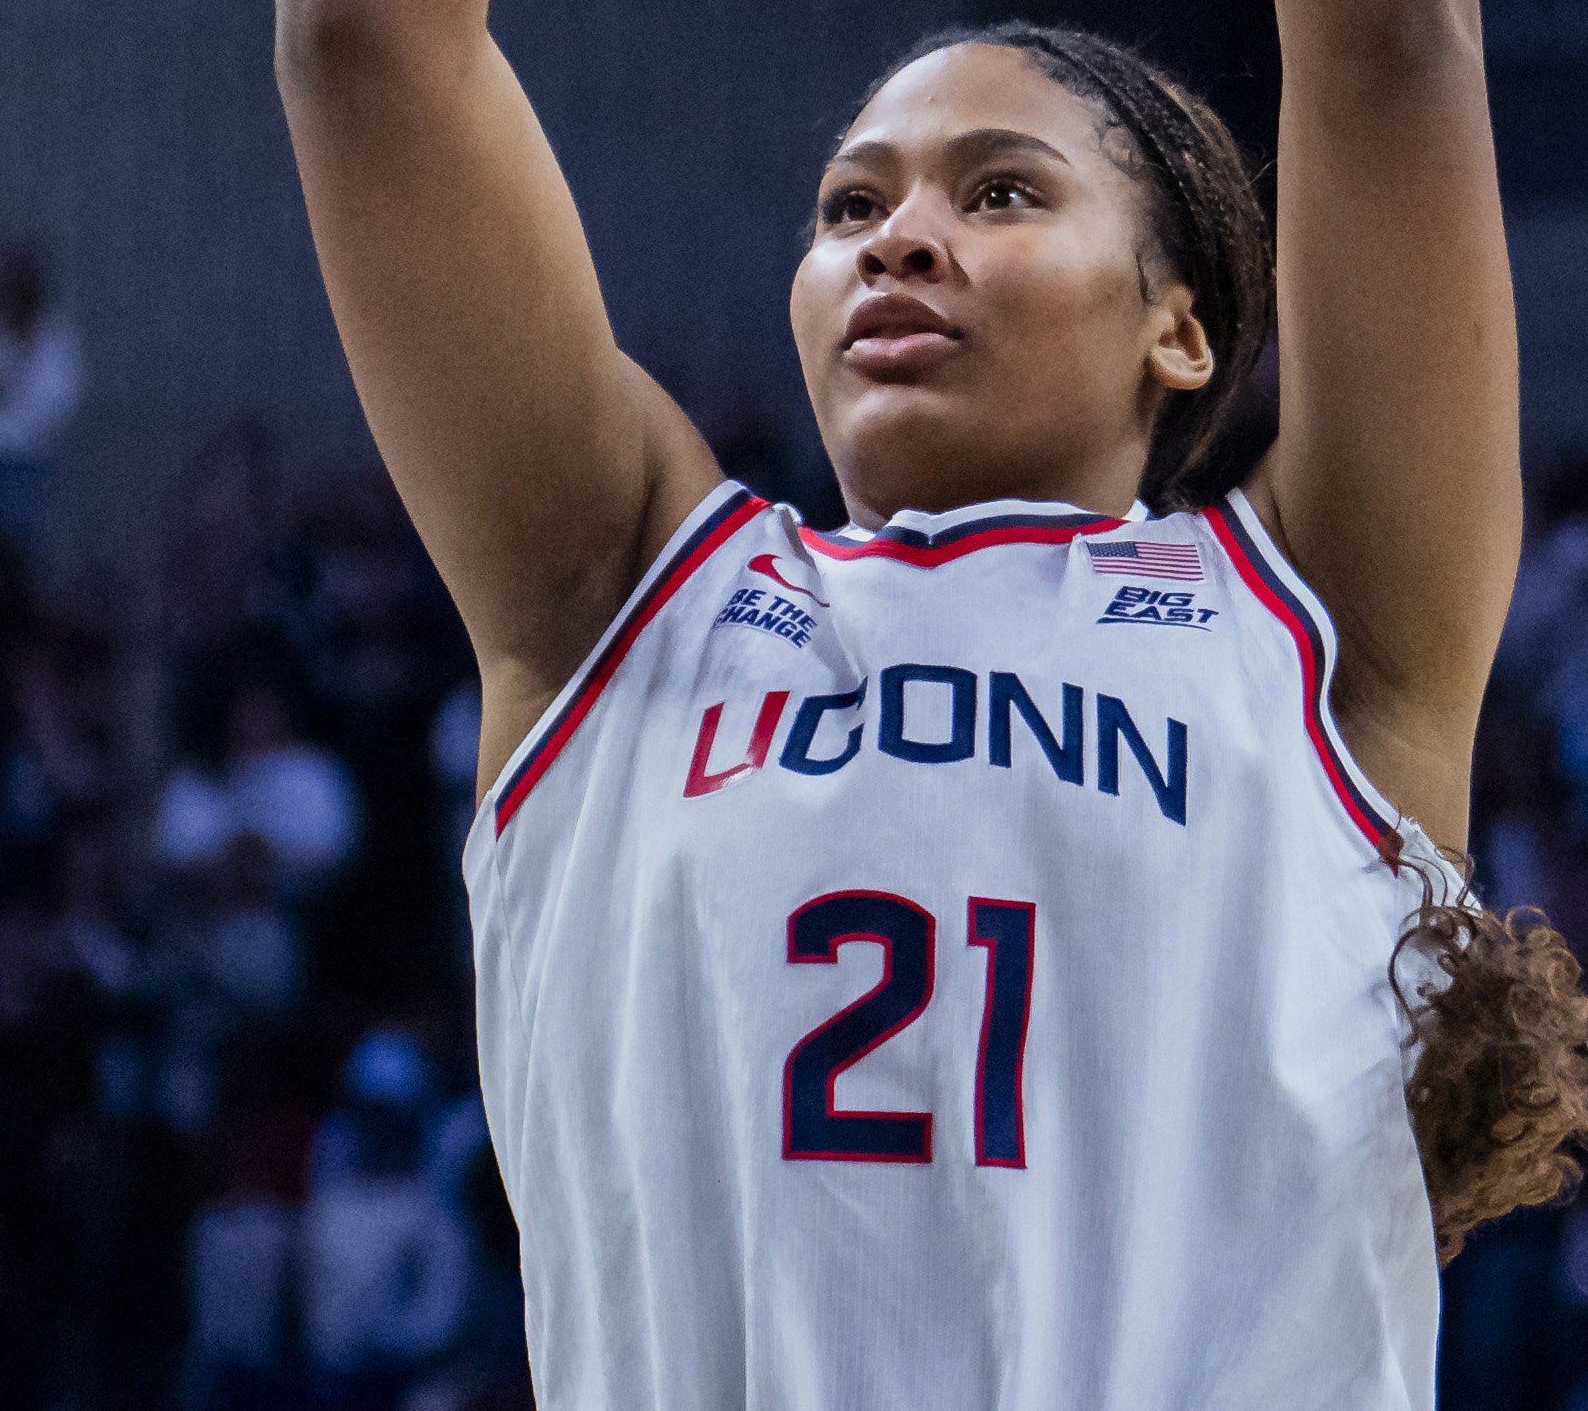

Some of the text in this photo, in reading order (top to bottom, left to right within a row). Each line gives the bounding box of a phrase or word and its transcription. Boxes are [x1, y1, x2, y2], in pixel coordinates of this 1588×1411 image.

[725, 589, 817, 633] BE THE
[1104, 601, 1219, 623] EAST
[1114, 586, 1196, 606] BIG
[683, 663, 1188, 826] UCONN
[782, 889, 1036, 1168] 21
